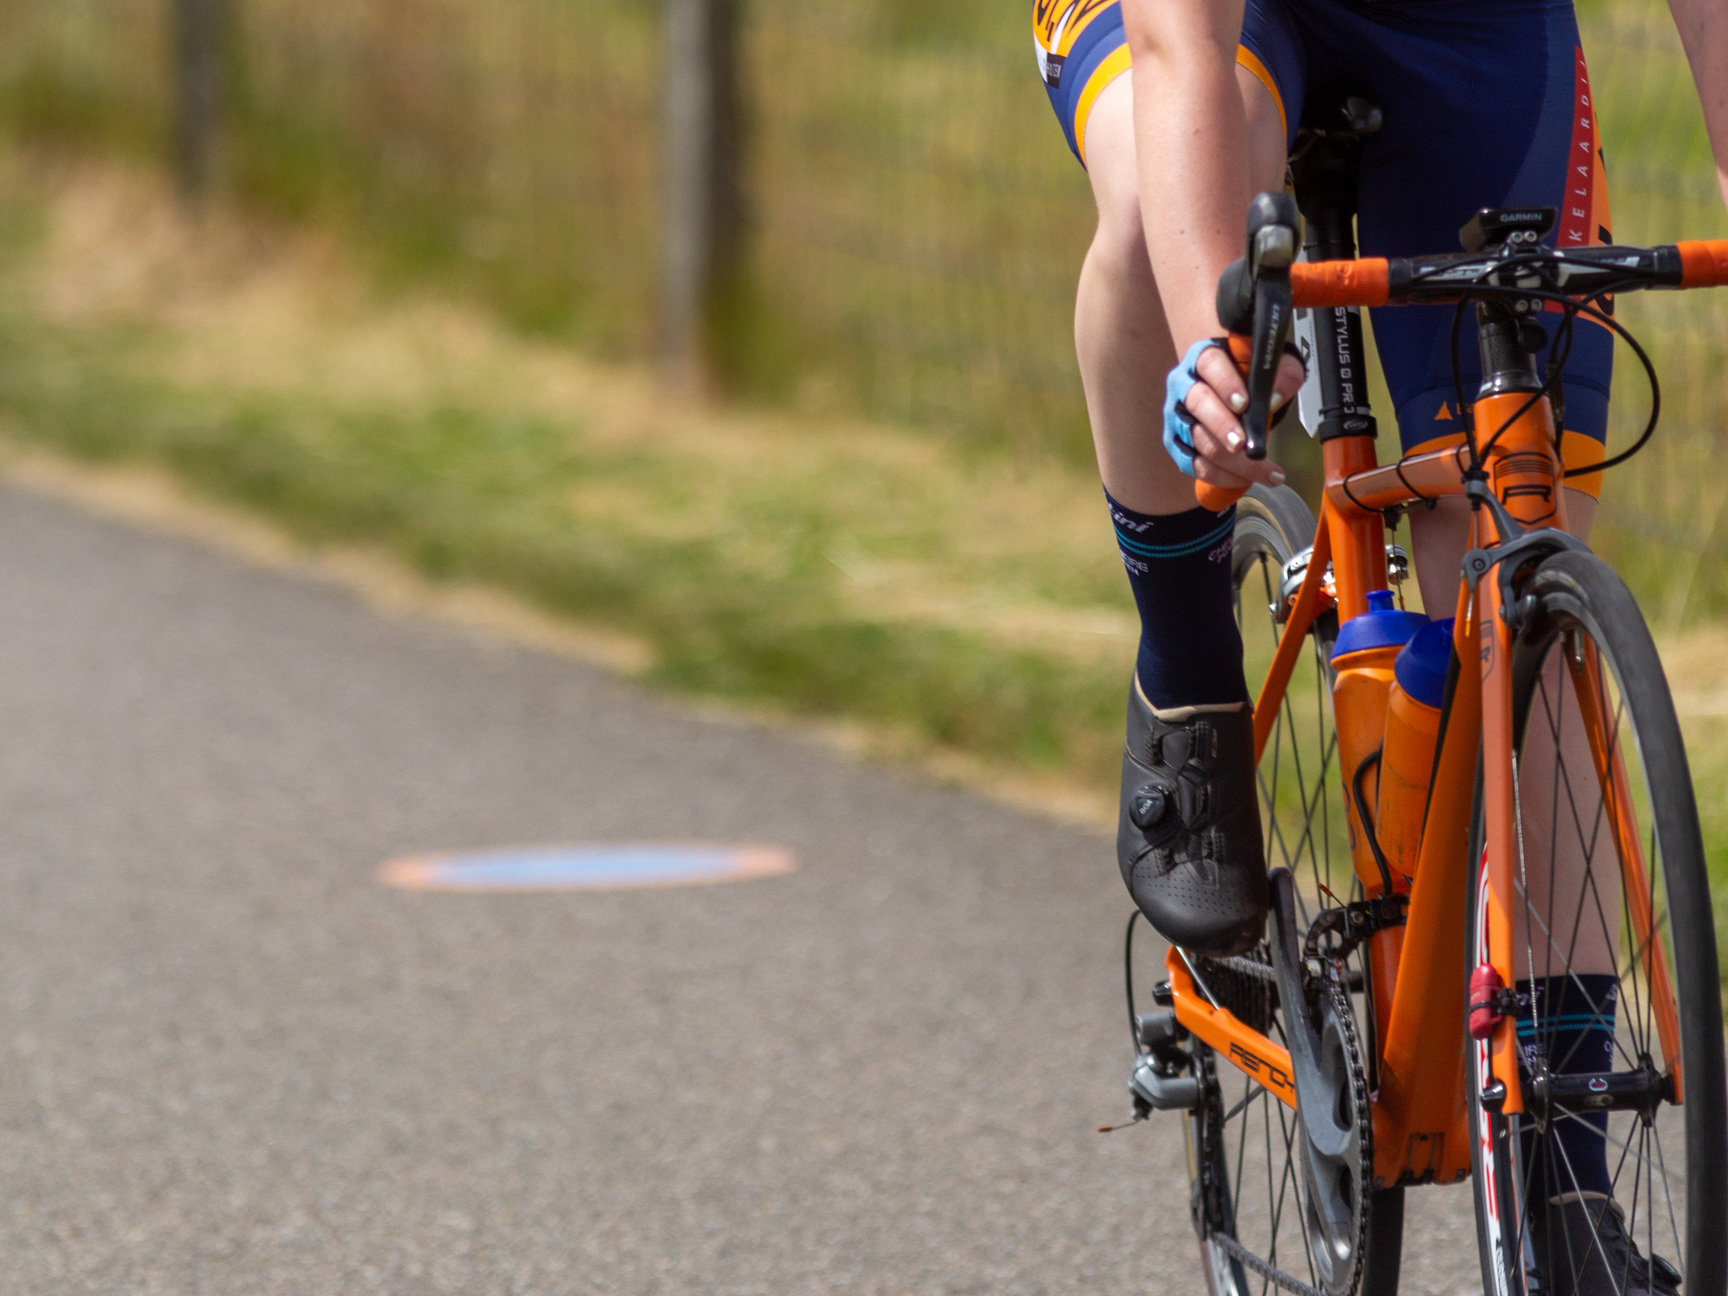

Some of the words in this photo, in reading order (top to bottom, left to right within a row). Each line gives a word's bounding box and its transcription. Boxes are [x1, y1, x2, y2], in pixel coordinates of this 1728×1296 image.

[1500, 212, 1543, 222] GARMIN
[1334, 307, 1350, 364] STYLUS
[1139, 798, 1154, 815] BOA
